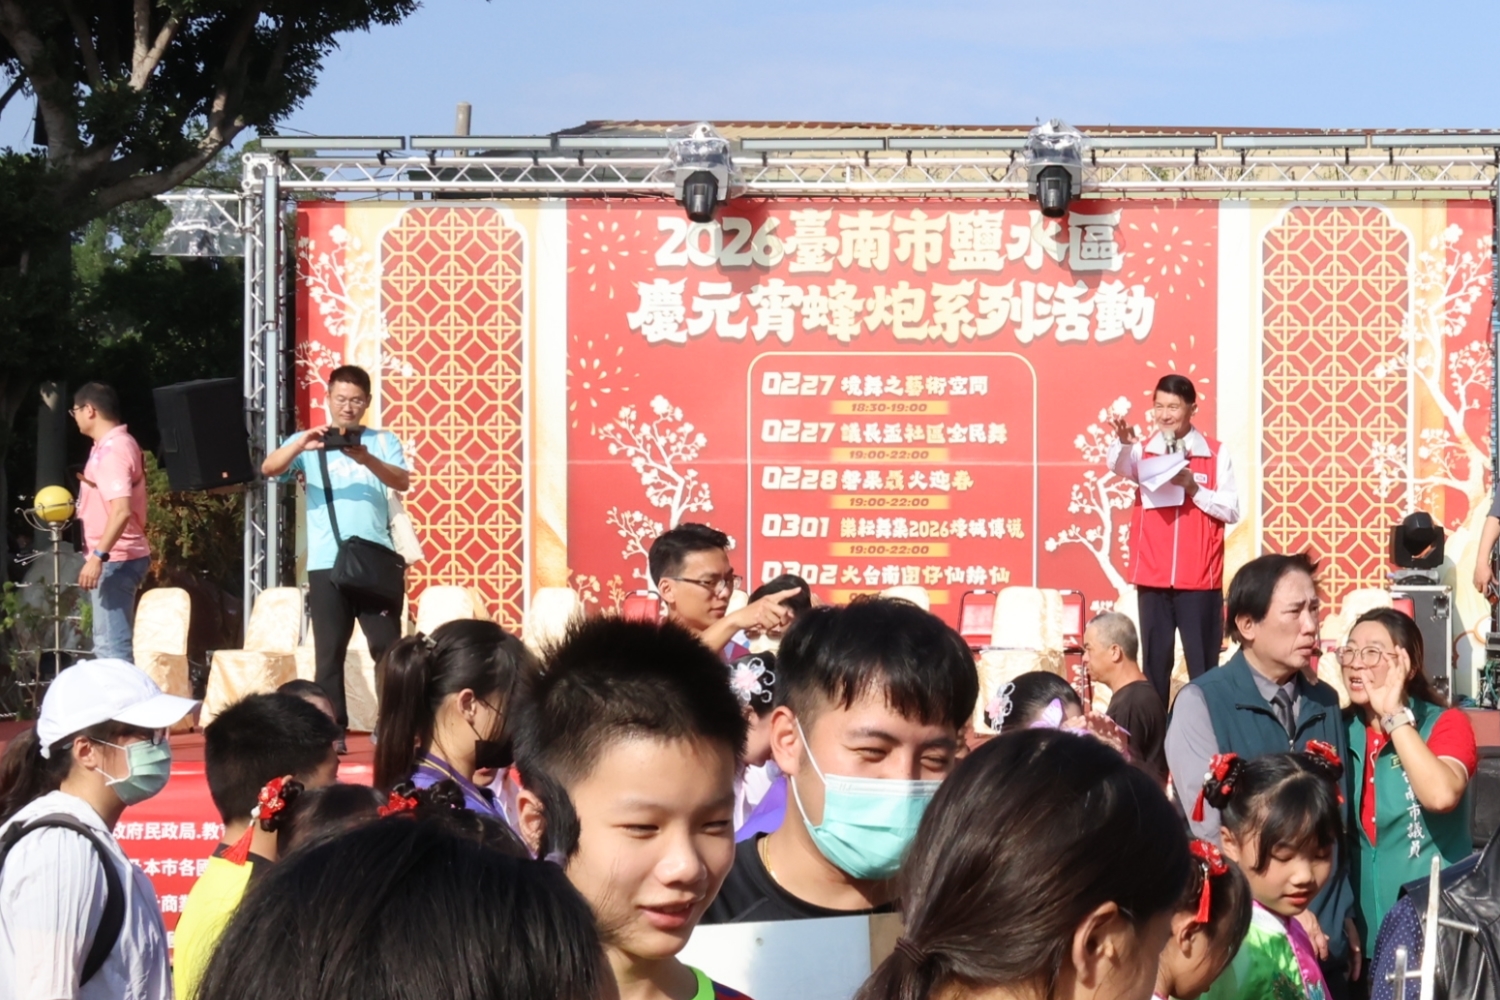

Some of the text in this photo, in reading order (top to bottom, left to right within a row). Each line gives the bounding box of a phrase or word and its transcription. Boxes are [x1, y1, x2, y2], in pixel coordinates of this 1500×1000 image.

[655, 207, 1125, 274] 2026臺南市鹽水區
[626, 276, 1157, 344] 慶元宵蜂炮系列活動
[761, 371, 836, 396] 0227
[851, 403, 928, 412] 18:30-19:00
[761, 418, 836, 443] 0227
[849, 450, 930, 460] 19:00-22:00
[761, 466, 838, 490] 0228
[849, 497, 930, 507] 19:00-22:00
[761, 514, 830, 538] 0301
[849, 545, 930, 554] 19:00-22:00
